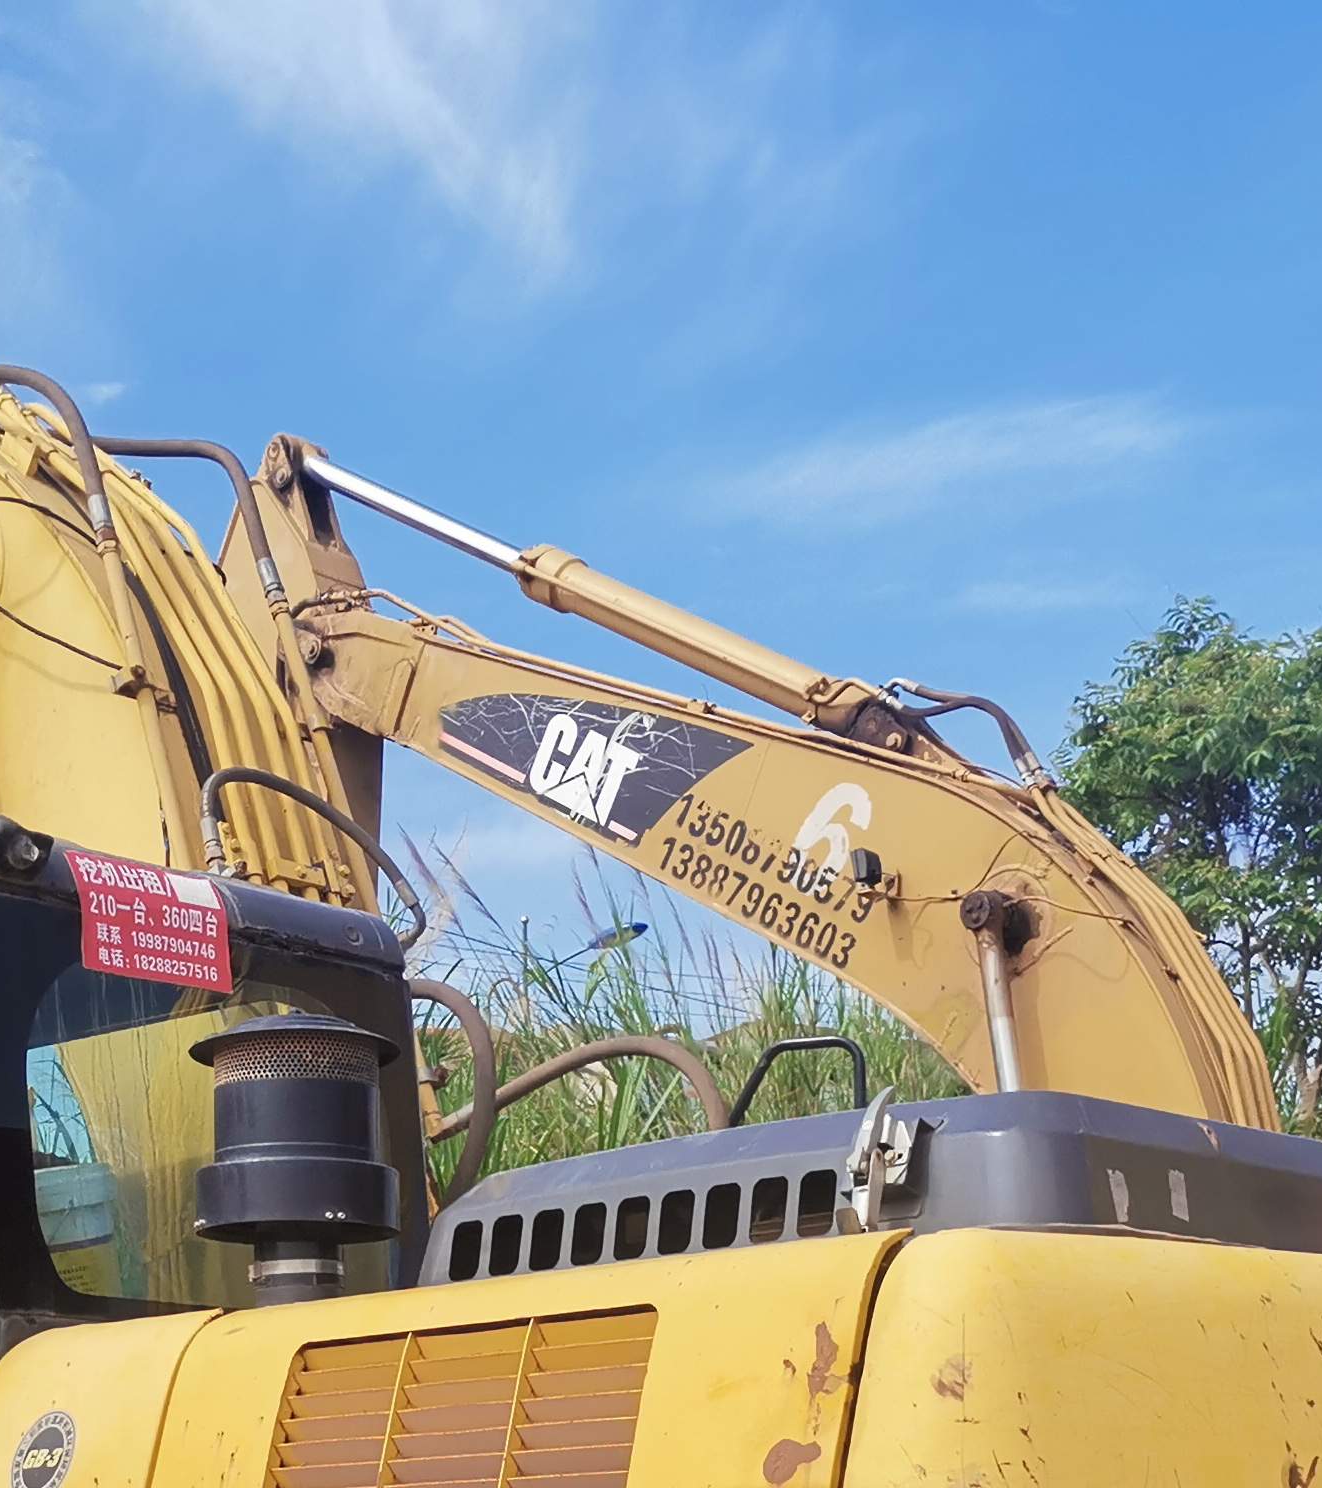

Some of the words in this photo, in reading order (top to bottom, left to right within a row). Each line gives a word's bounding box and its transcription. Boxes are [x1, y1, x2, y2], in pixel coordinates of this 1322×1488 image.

[529, 713, 641, 828] CAT
[96, 922, 122, 945] 联系
[130, 931, 216, 960] 19987904746
[659, 837, 857, 969] 13887963603
